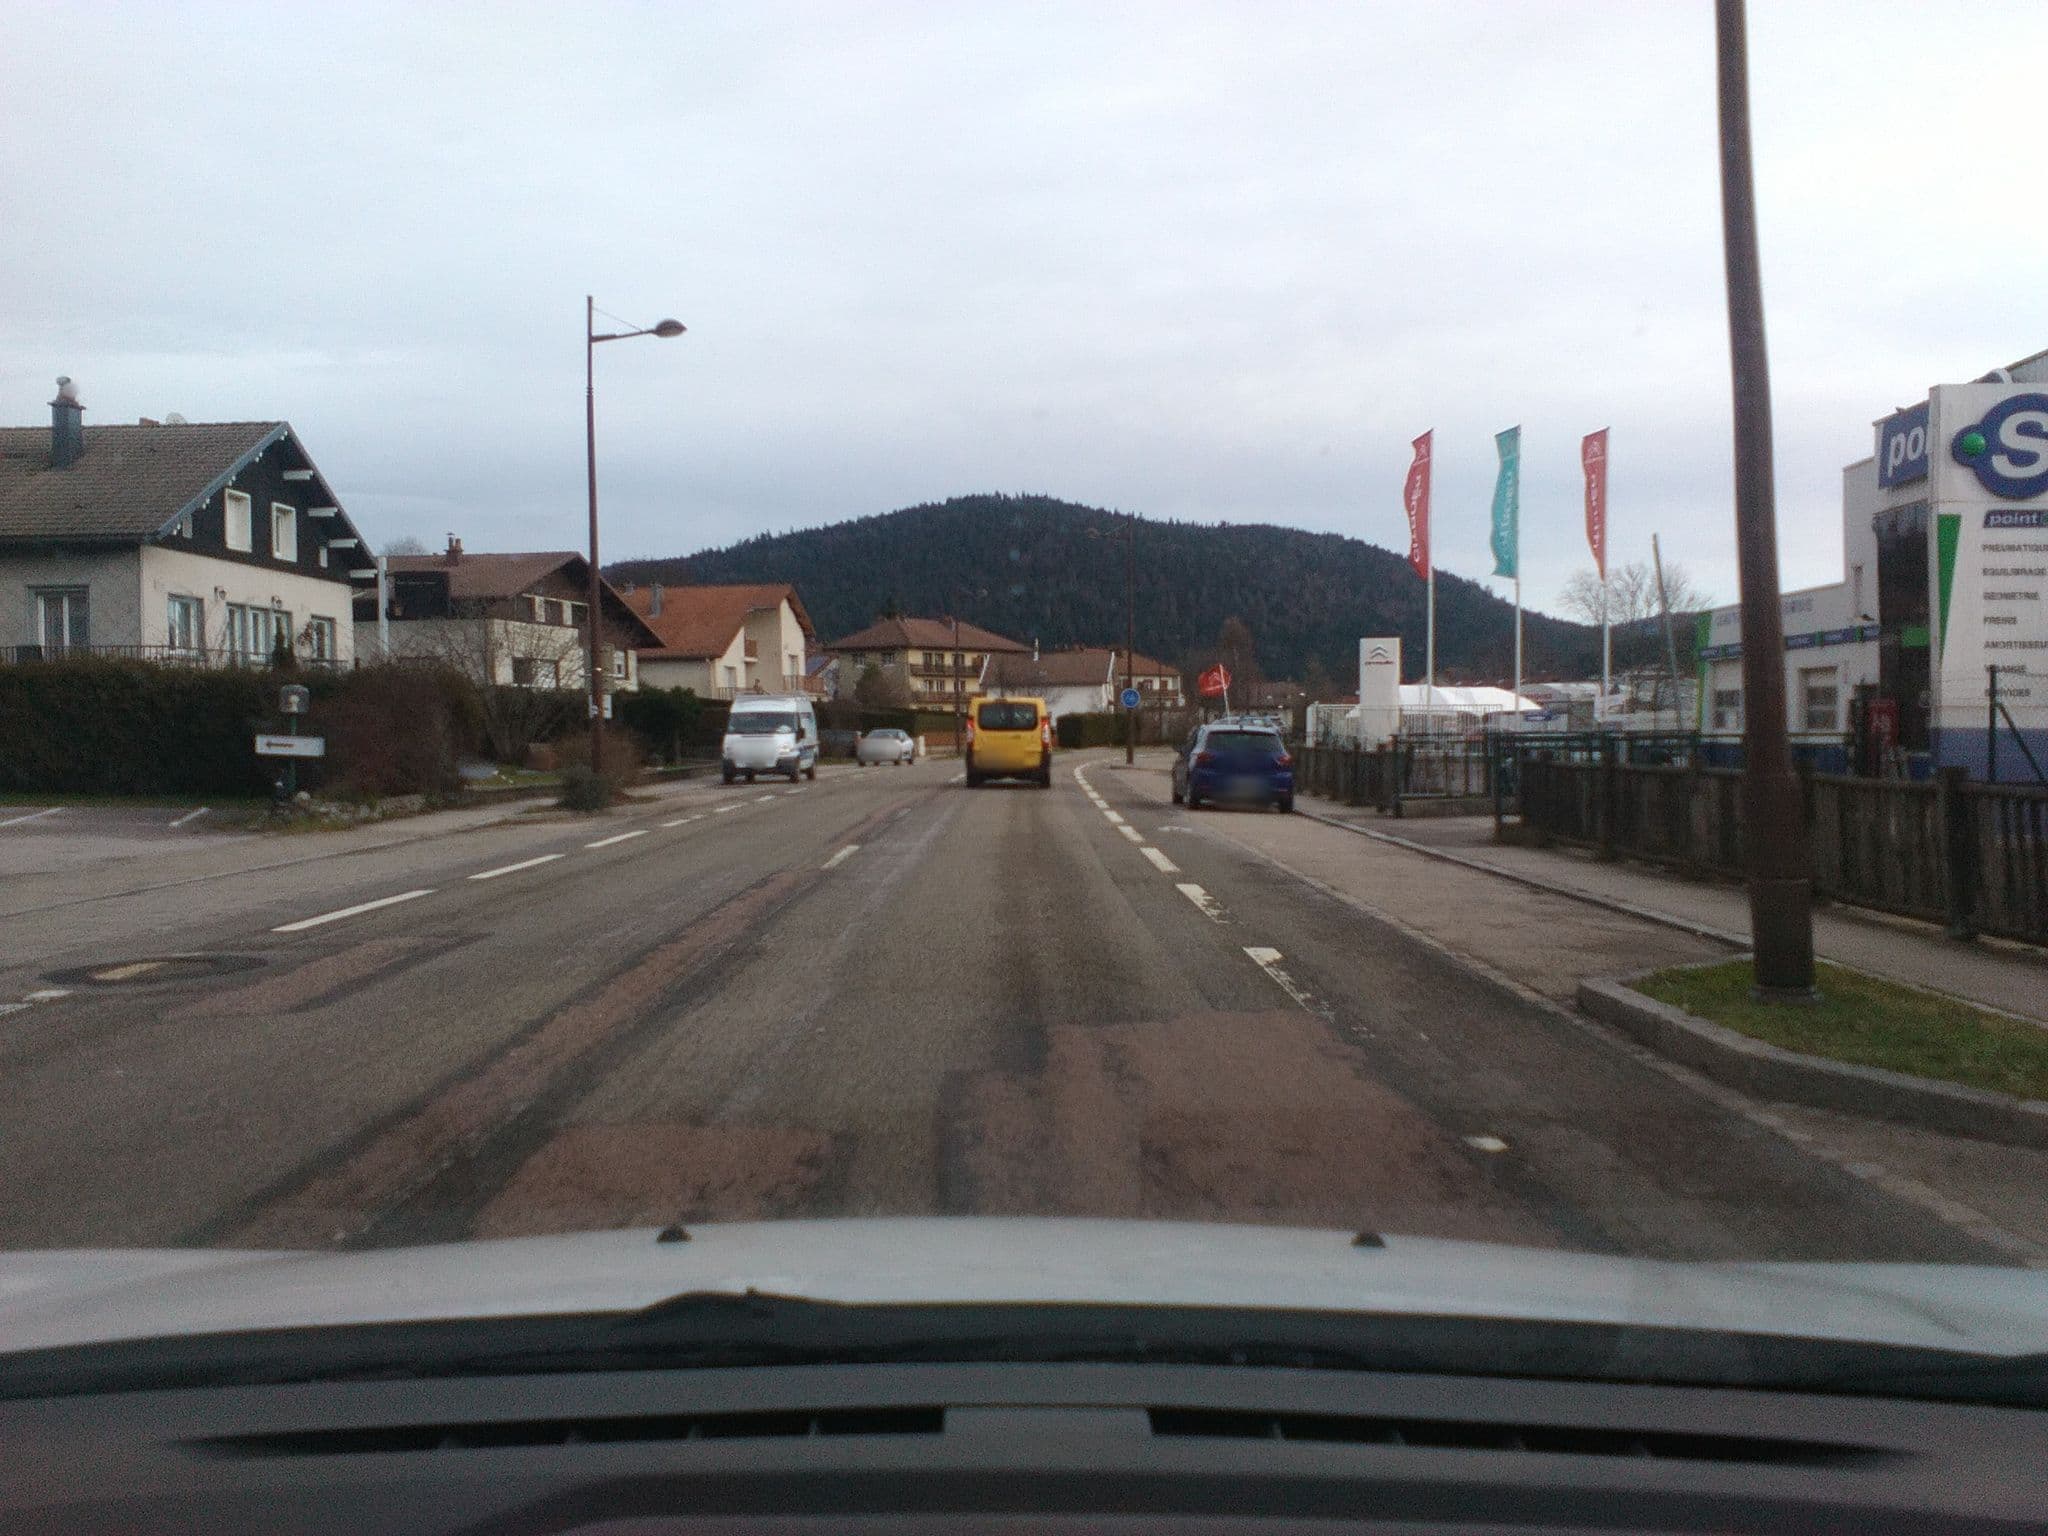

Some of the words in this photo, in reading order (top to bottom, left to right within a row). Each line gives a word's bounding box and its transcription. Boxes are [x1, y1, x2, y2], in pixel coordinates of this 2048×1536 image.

[1887, 426, 1927, 478] po
[1991, 410, 2048, 478] S
[1988, 511, 2038, 528] point
